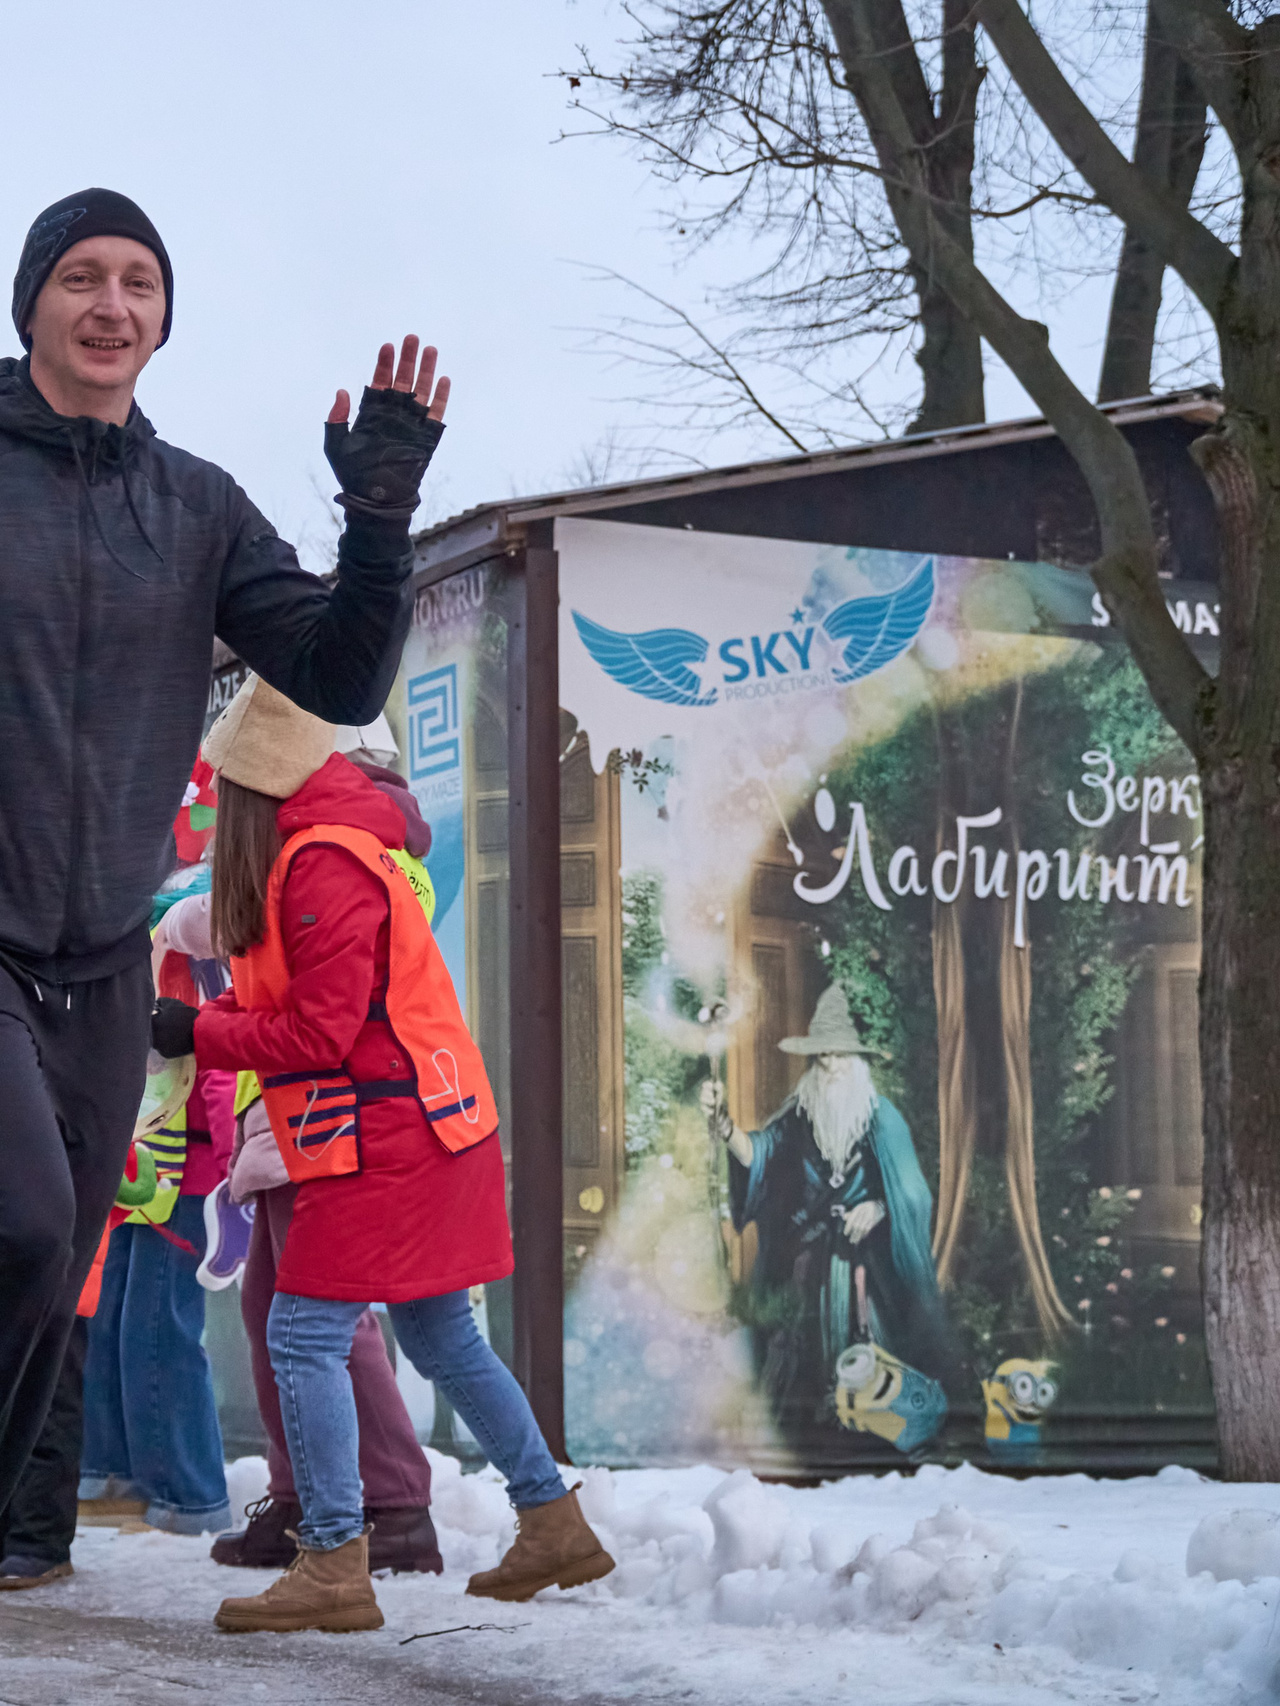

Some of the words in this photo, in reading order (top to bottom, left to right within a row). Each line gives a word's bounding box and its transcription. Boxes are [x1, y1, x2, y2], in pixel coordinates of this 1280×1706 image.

[719, 626, 815, 683] SKY
[724, 673, 827, 702] PRODUCTION
[1067, 744, 1204, 848] Зерк
[793, 801, 1193, 949] Лабиринт
